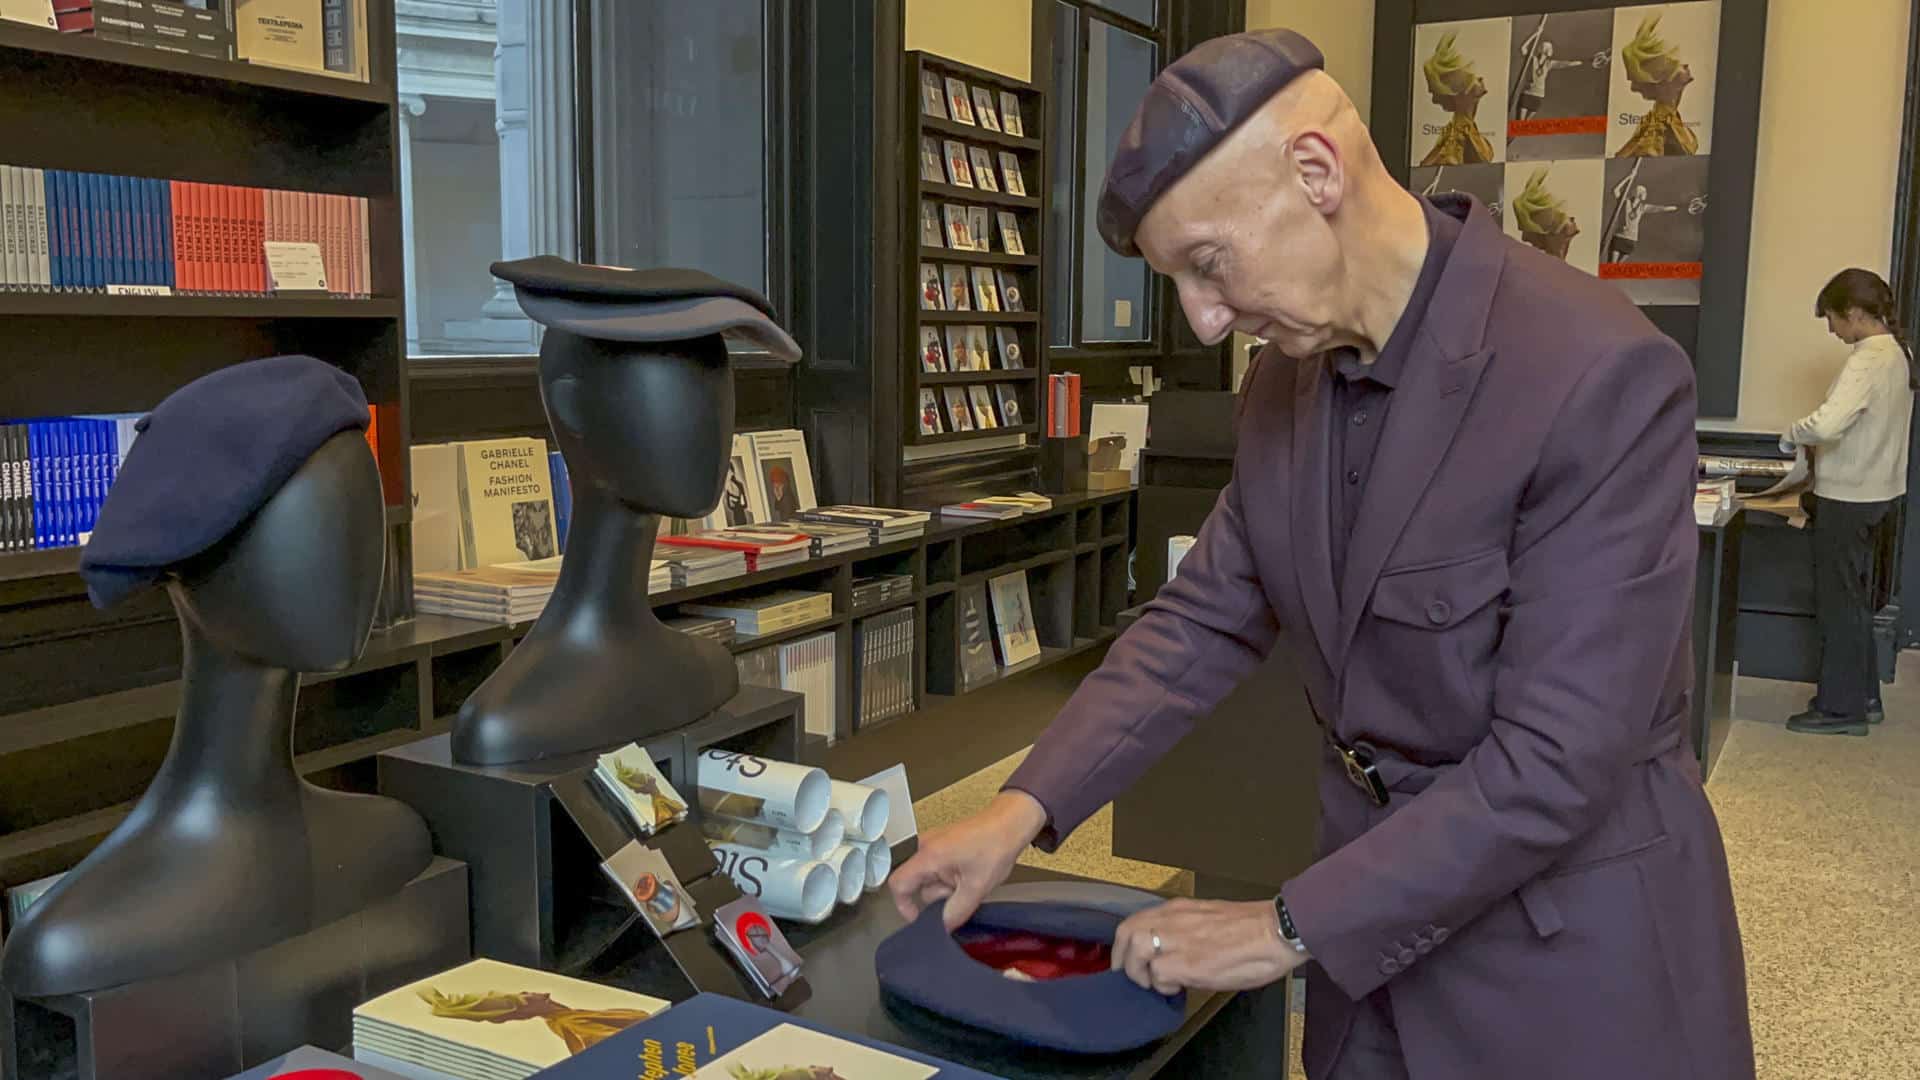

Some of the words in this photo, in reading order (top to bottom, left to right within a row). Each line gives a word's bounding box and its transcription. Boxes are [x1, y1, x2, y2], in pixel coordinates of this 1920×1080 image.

[175, 215, 184, 260] BALMAIN
[184, 216, 193, 262] BALMAIN
[194, 216, 202, 262] BALMAIN
[203, 217, 211, 263] BALMAIN
[212, 217, 220, 263] BALMAIN
[222, 219, 230, 263] BALMAIN
[231, 219, 239, 263] BALMAIN
[240, 219, 248, 264] BALMAIN
[249, 220, 258, 264] BALMAIN
[481, 448, 535, 459] GABRIELLE
[490, 459, 529, 470] CHANEL
[2, 462, 12, 501] CHANEL
[12, 461, 22, 501] CHANEL
[22, 460, 32, 499] CHANEL
[483, 484, 541, 497] MANIFESTO
[489, 474, 533, 486] FASHION
